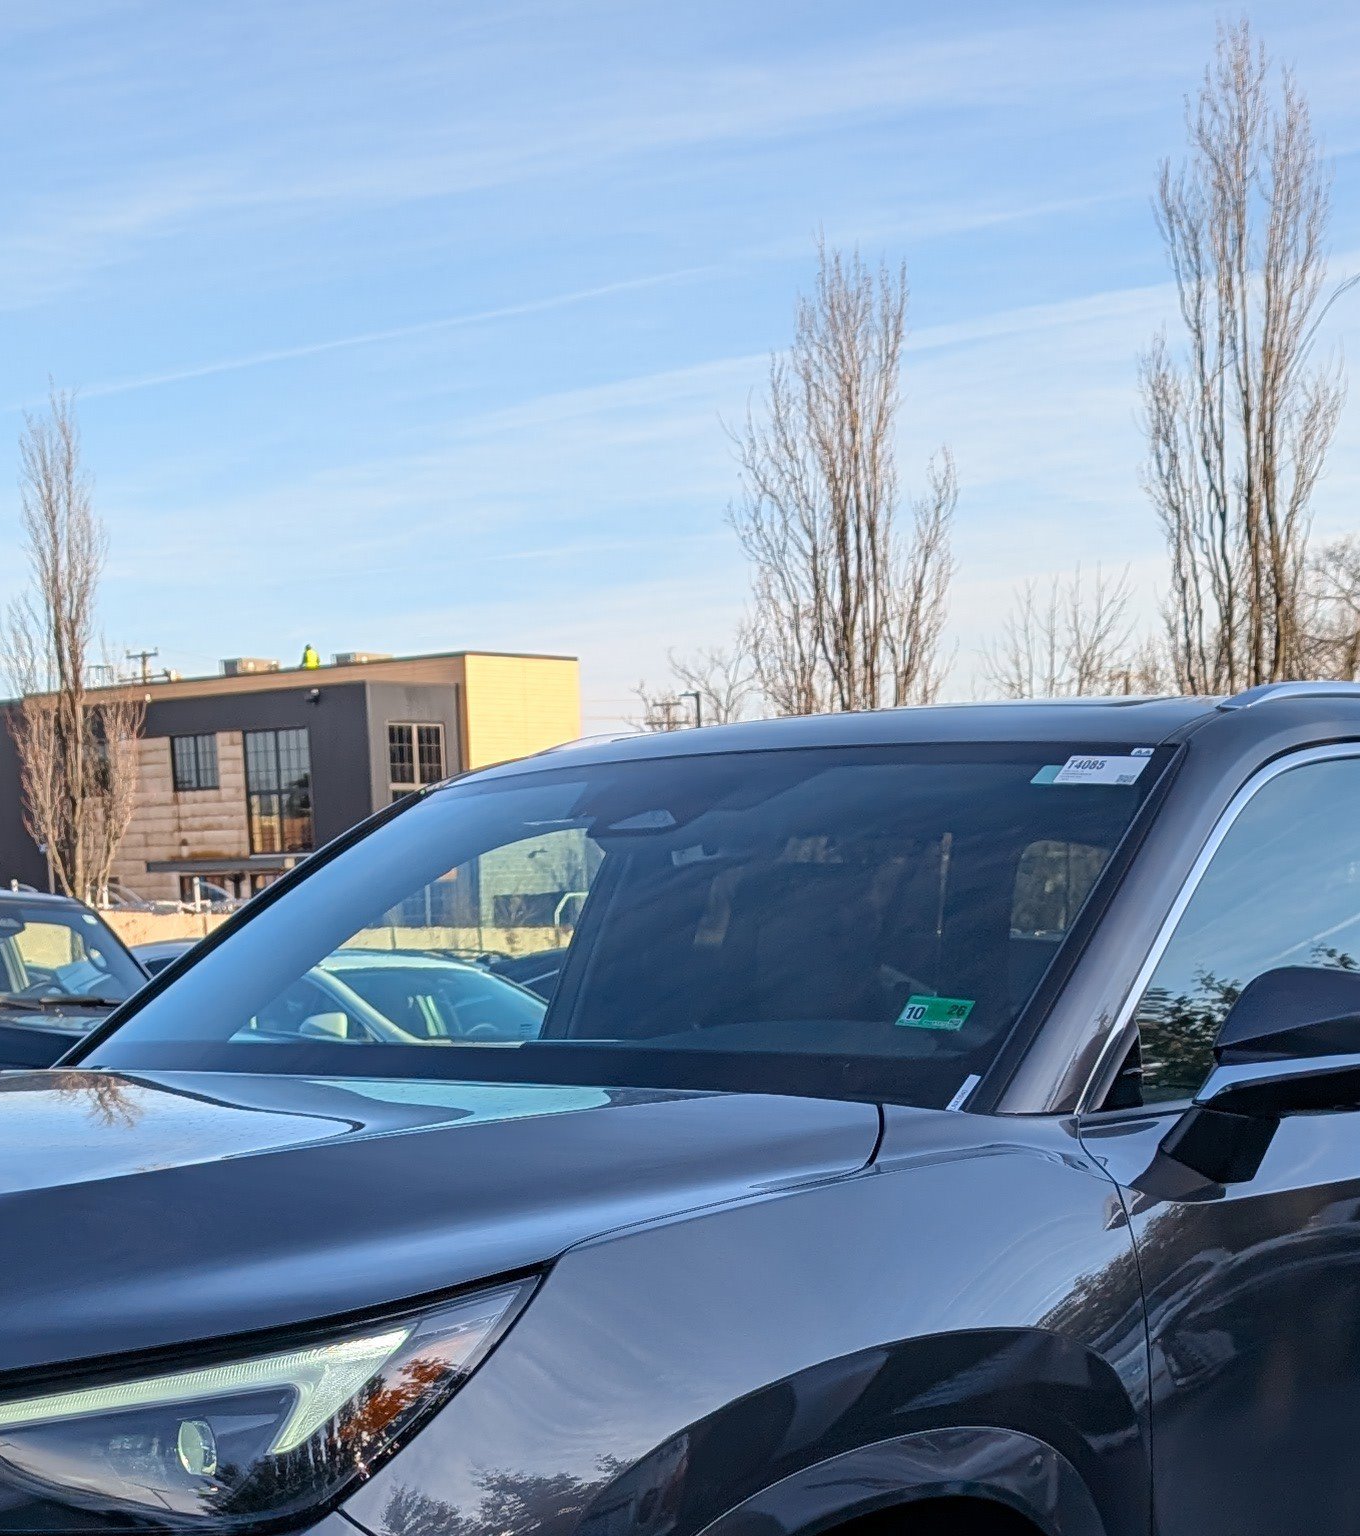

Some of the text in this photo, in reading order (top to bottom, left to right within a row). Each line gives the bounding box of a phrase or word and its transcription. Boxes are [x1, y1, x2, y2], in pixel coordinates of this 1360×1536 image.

[1067, 759, 1108, 770] T4085
[905, 1006, 926, 1020] 10
[946, 1004, 968, 1017] 26
